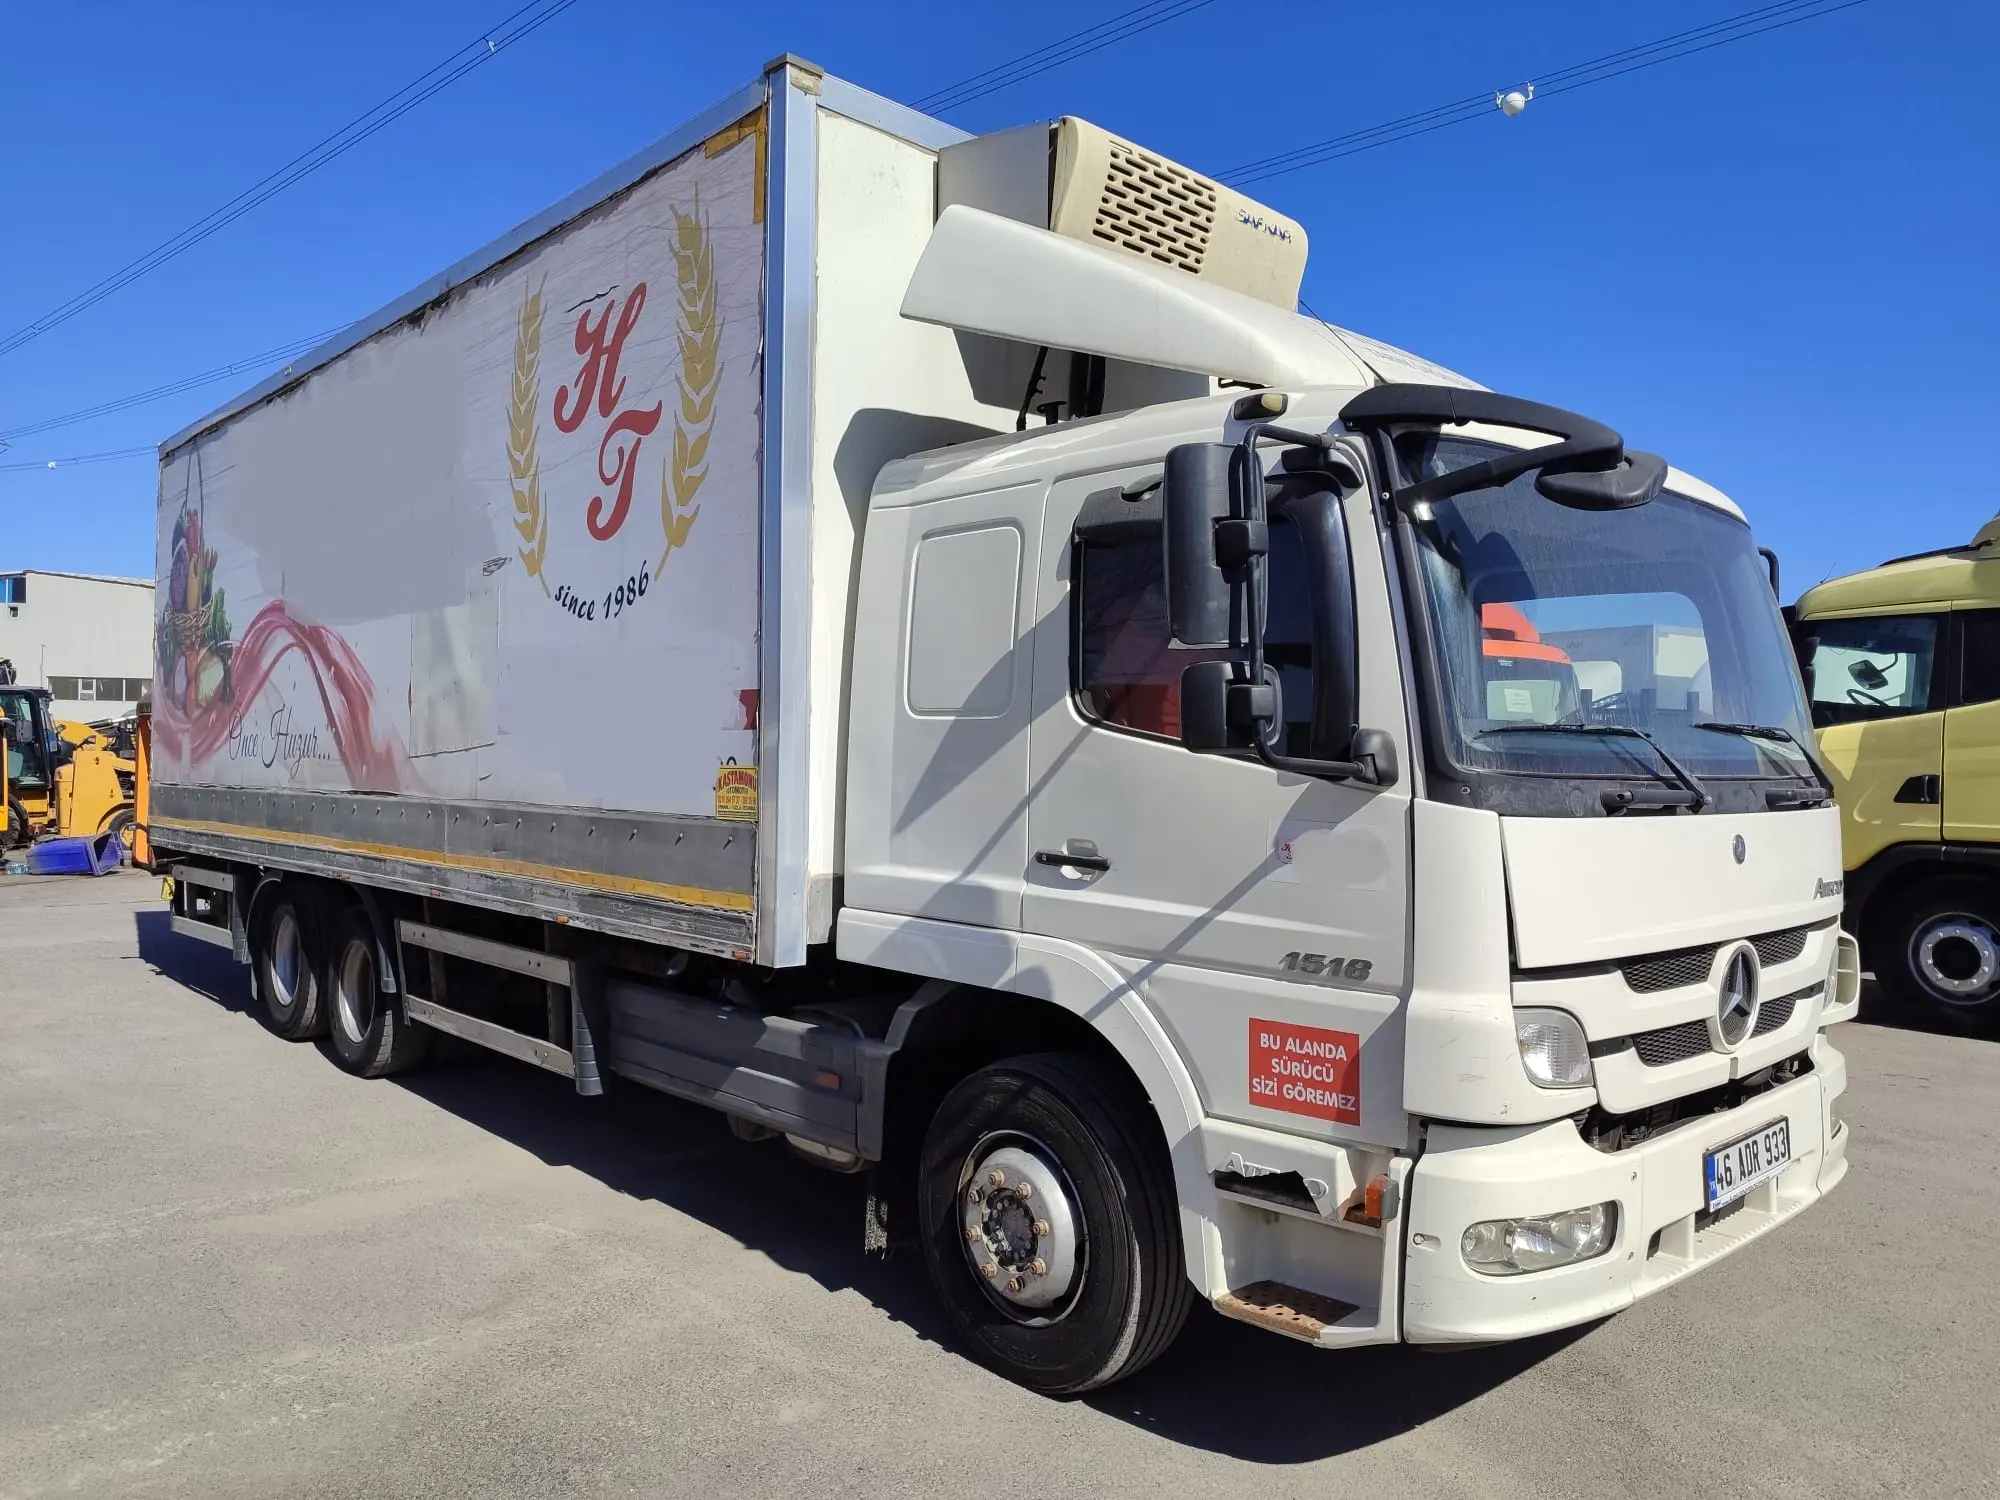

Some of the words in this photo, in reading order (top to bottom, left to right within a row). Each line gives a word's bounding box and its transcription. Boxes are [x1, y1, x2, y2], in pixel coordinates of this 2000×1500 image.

[554, 585, 596, 621] since
[603, 559, 649, 620] 1986
[1279, 951, 1373, 981] 1518
[1260, 1032, 1281, 1050] BU
[1285, 1036, 1347, 1062] ALANDA
[1271, 1055, 1334, 1083] SÜRÜCÜ
[1252, 1074, 1278, 1097] SİZİ
[1282, 1081, 1356, 1111] GÖREMEZ
[1716, 1153, 1733, 1191] 46
[1738, 1139, 1761, 1182] ADR
[1764, 1126, 1787, 1166] 933
